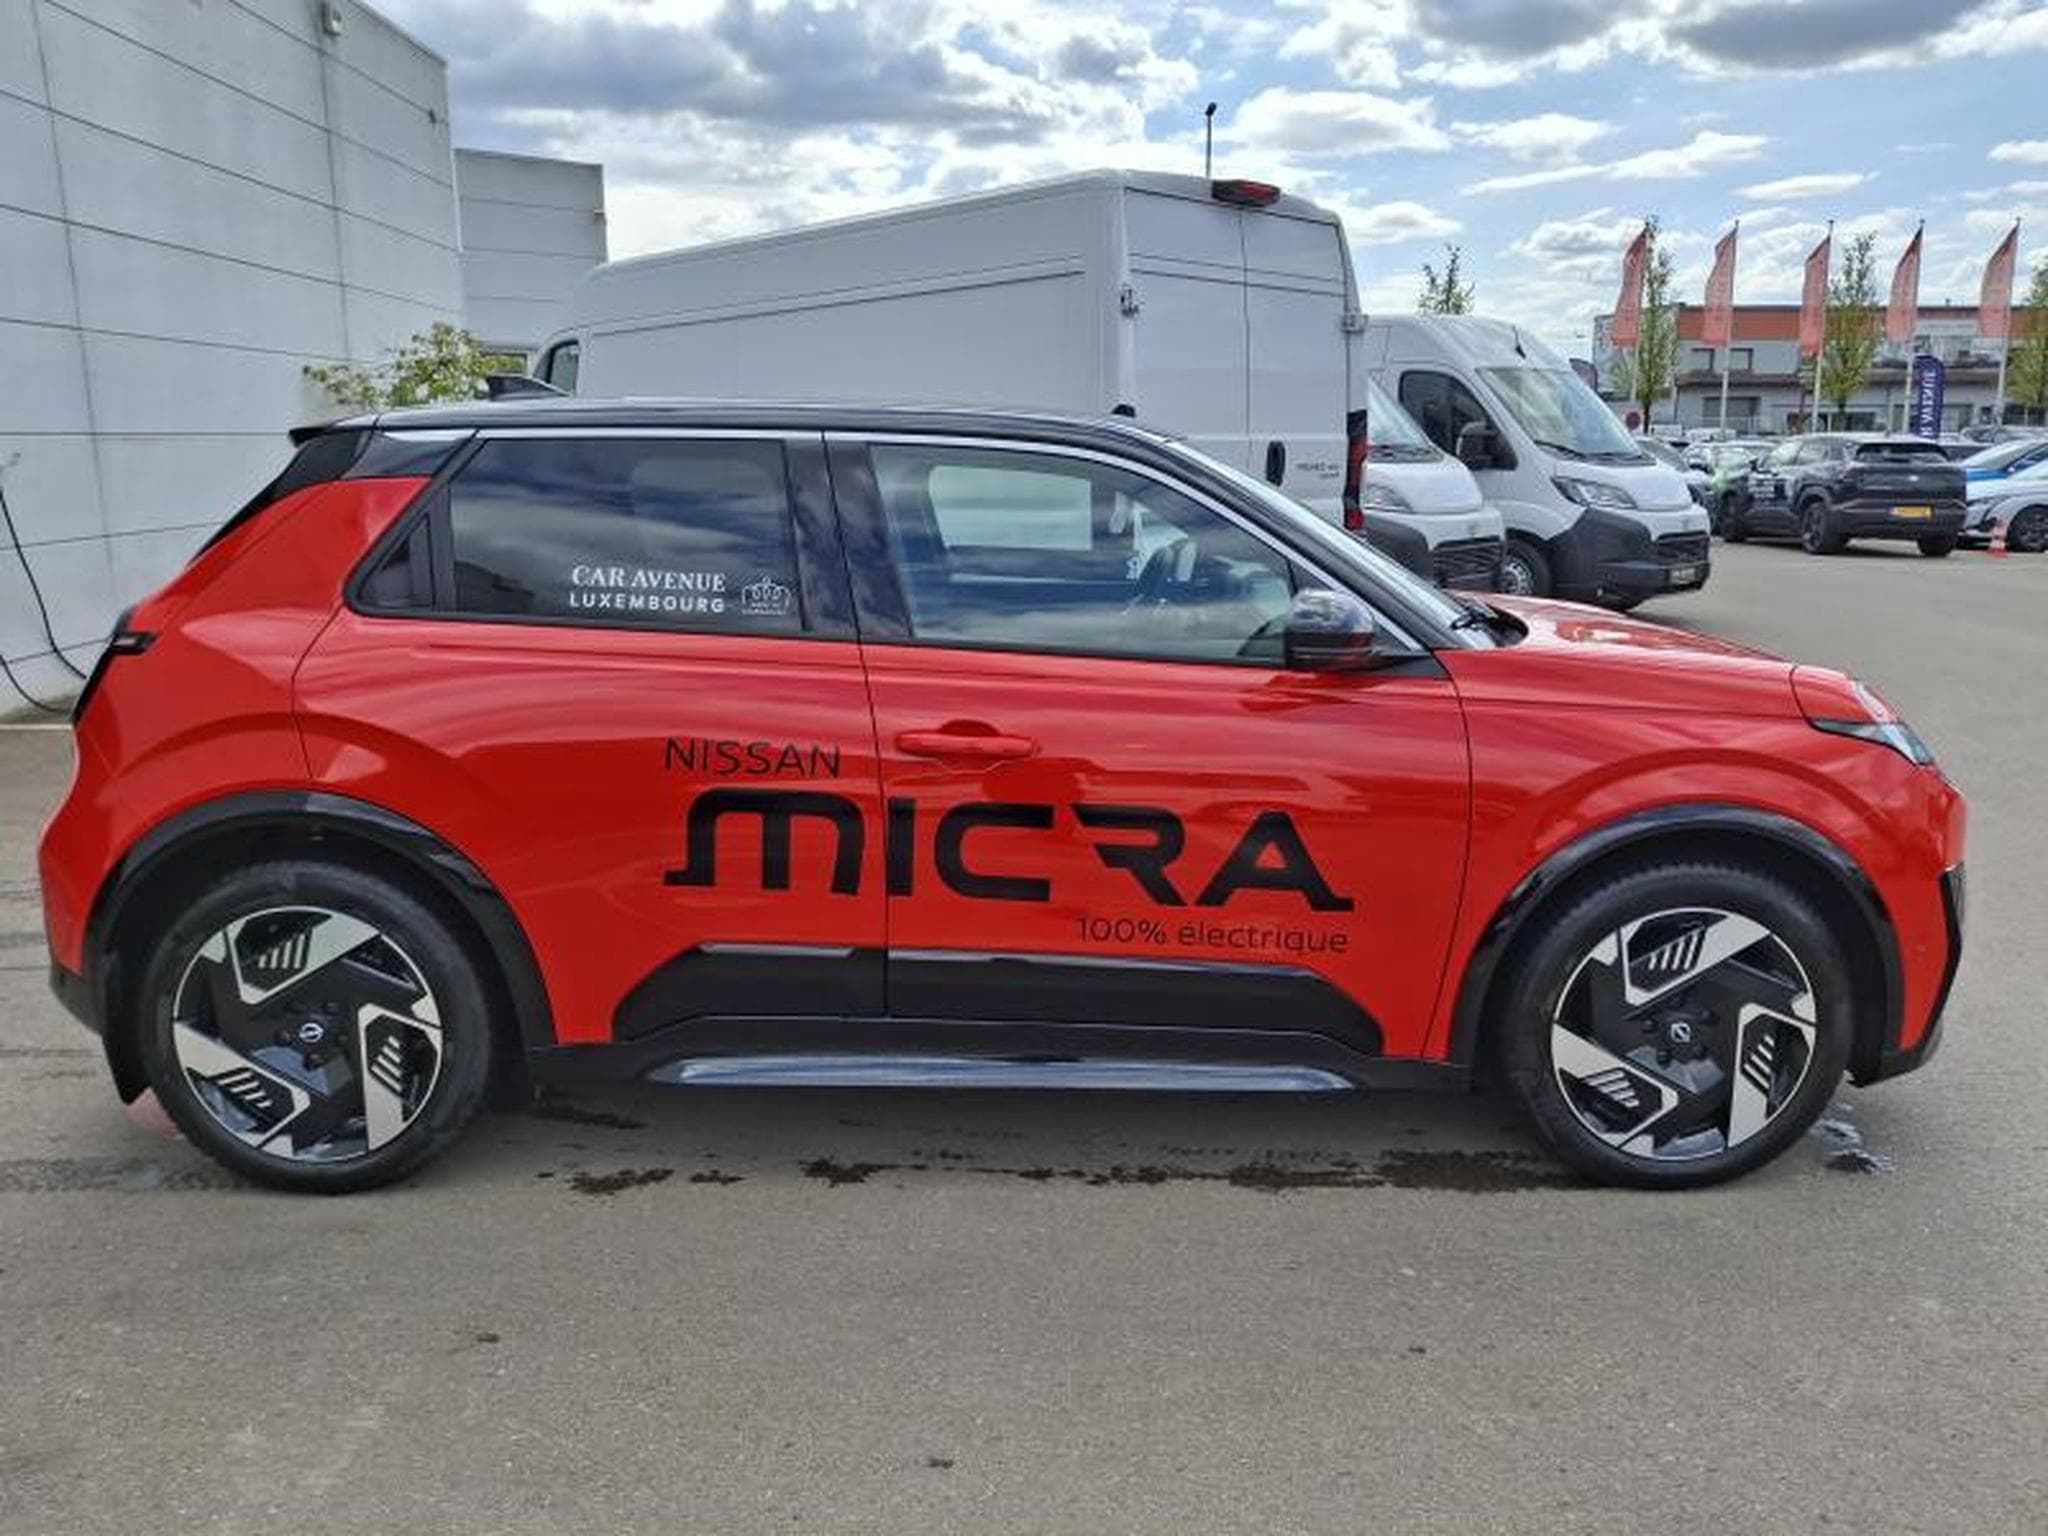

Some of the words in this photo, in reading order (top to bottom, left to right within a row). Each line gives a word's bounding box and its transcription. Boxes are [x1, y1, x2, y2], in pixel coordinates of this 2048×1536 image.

[572, 565, 625, 587] CAR
[631, 568, 726, 592] AVENUE
[570, 592, 725, 612] LUXEMBOURG
[664, 737, 840, 778] NISSAN
[664, 787, 1354, 912] MICRA
[1078, 917, 1167, 945] 100%
[1178, 919, 1349, 954] électrique
